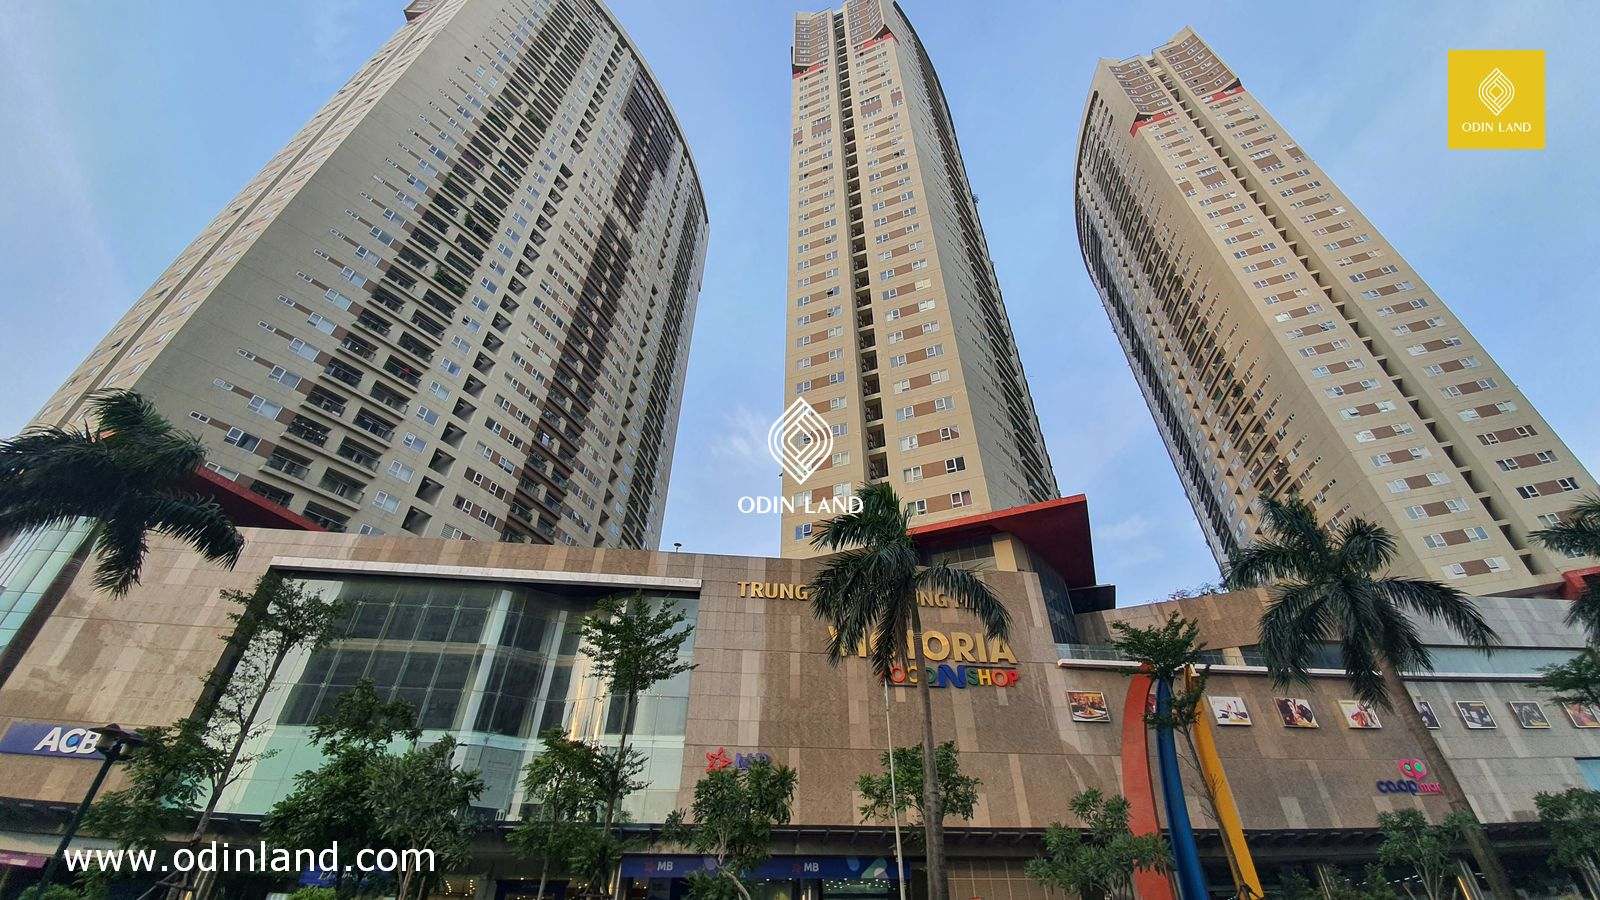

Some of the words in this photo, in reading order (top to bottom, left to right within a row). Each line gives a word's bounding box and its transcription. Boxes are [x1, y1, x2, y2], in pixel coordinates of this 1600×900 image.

[737, 581, 809, 600] TRUNG
[827, 625, 1018, 665] IORIA
[33, 726, 102, 754] ACB
[657, 861, 674, 871] MB
[803, 862, 819, 872] MB
